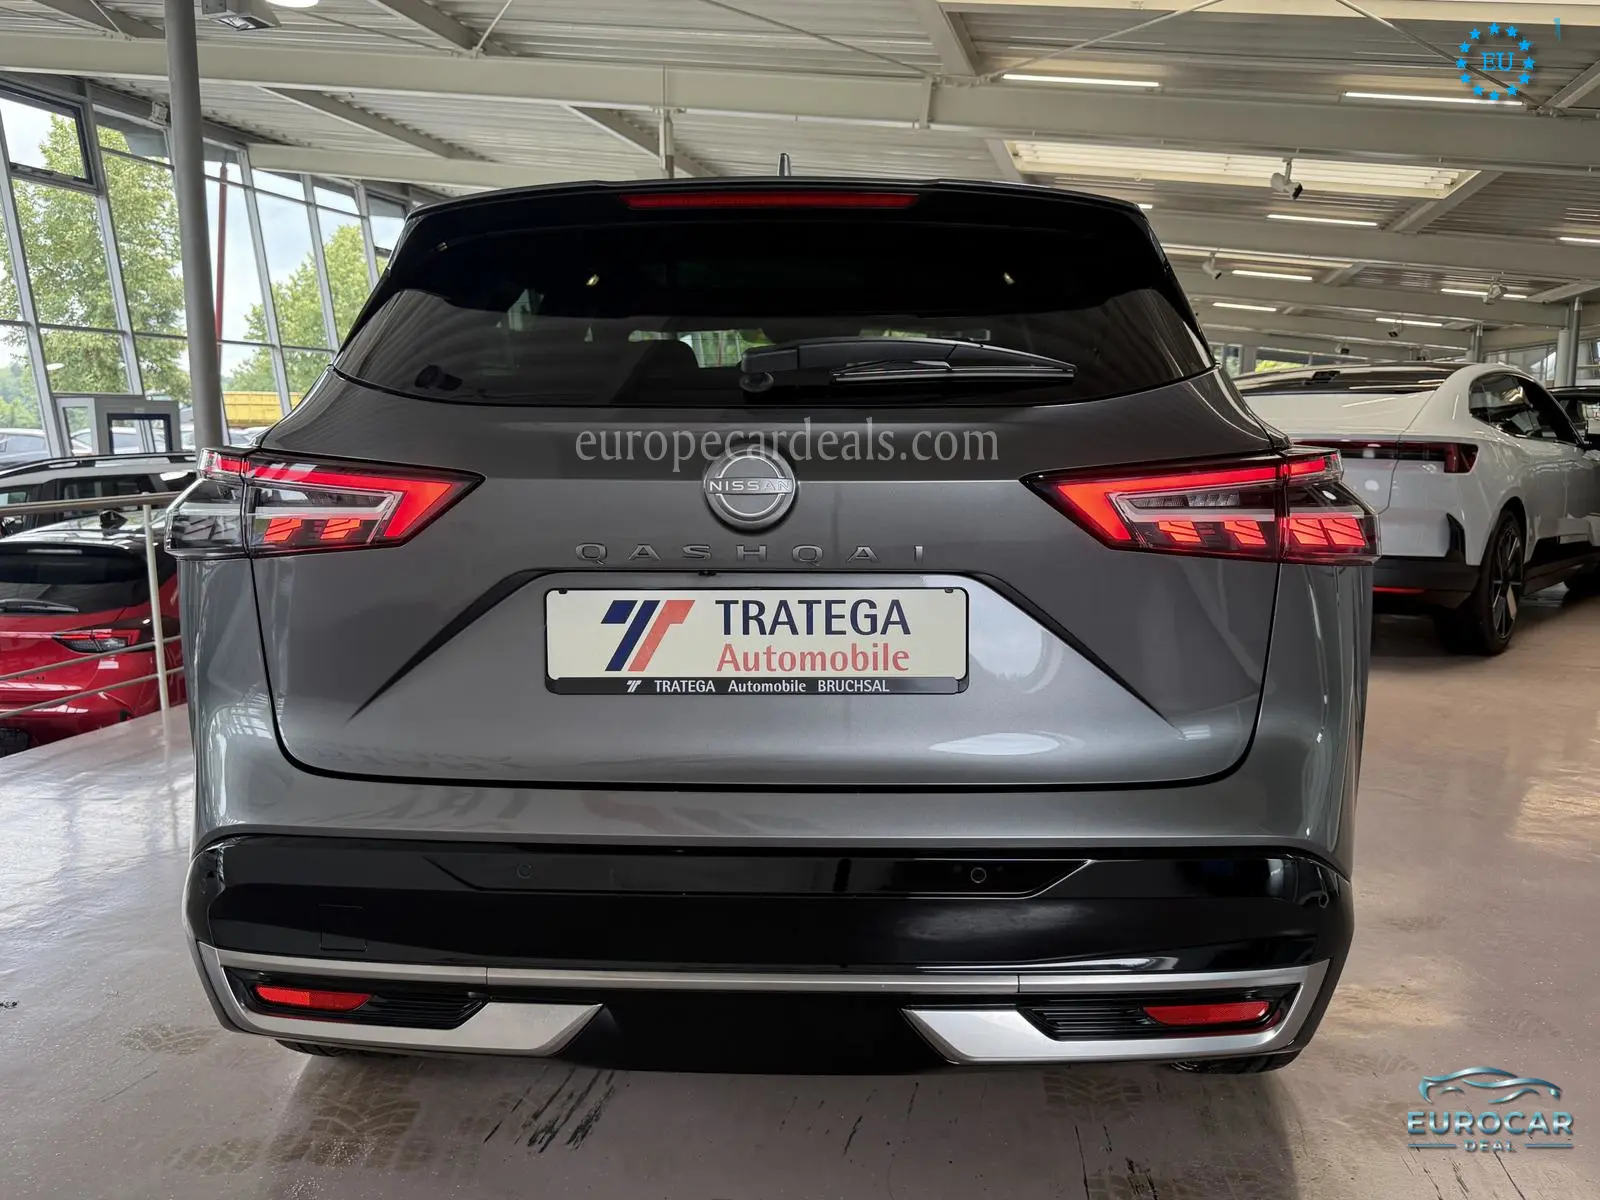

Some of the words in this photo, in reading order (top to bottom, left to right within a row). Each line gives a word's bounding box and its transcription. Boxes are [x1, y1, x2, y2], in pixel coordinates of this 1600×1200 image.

[709, 480, 790, 492] NISSAN
[575, 543, 924, 566] QASHQAI
[715, 598, 911, 636] TRATEGA
[716, 642, 910, 673] Automobile
[654, 680, 716, 693] TRATEGA
[728, 679, 807, 693] Automobile
[818, 679, 890, 693] BRUCHSAL
